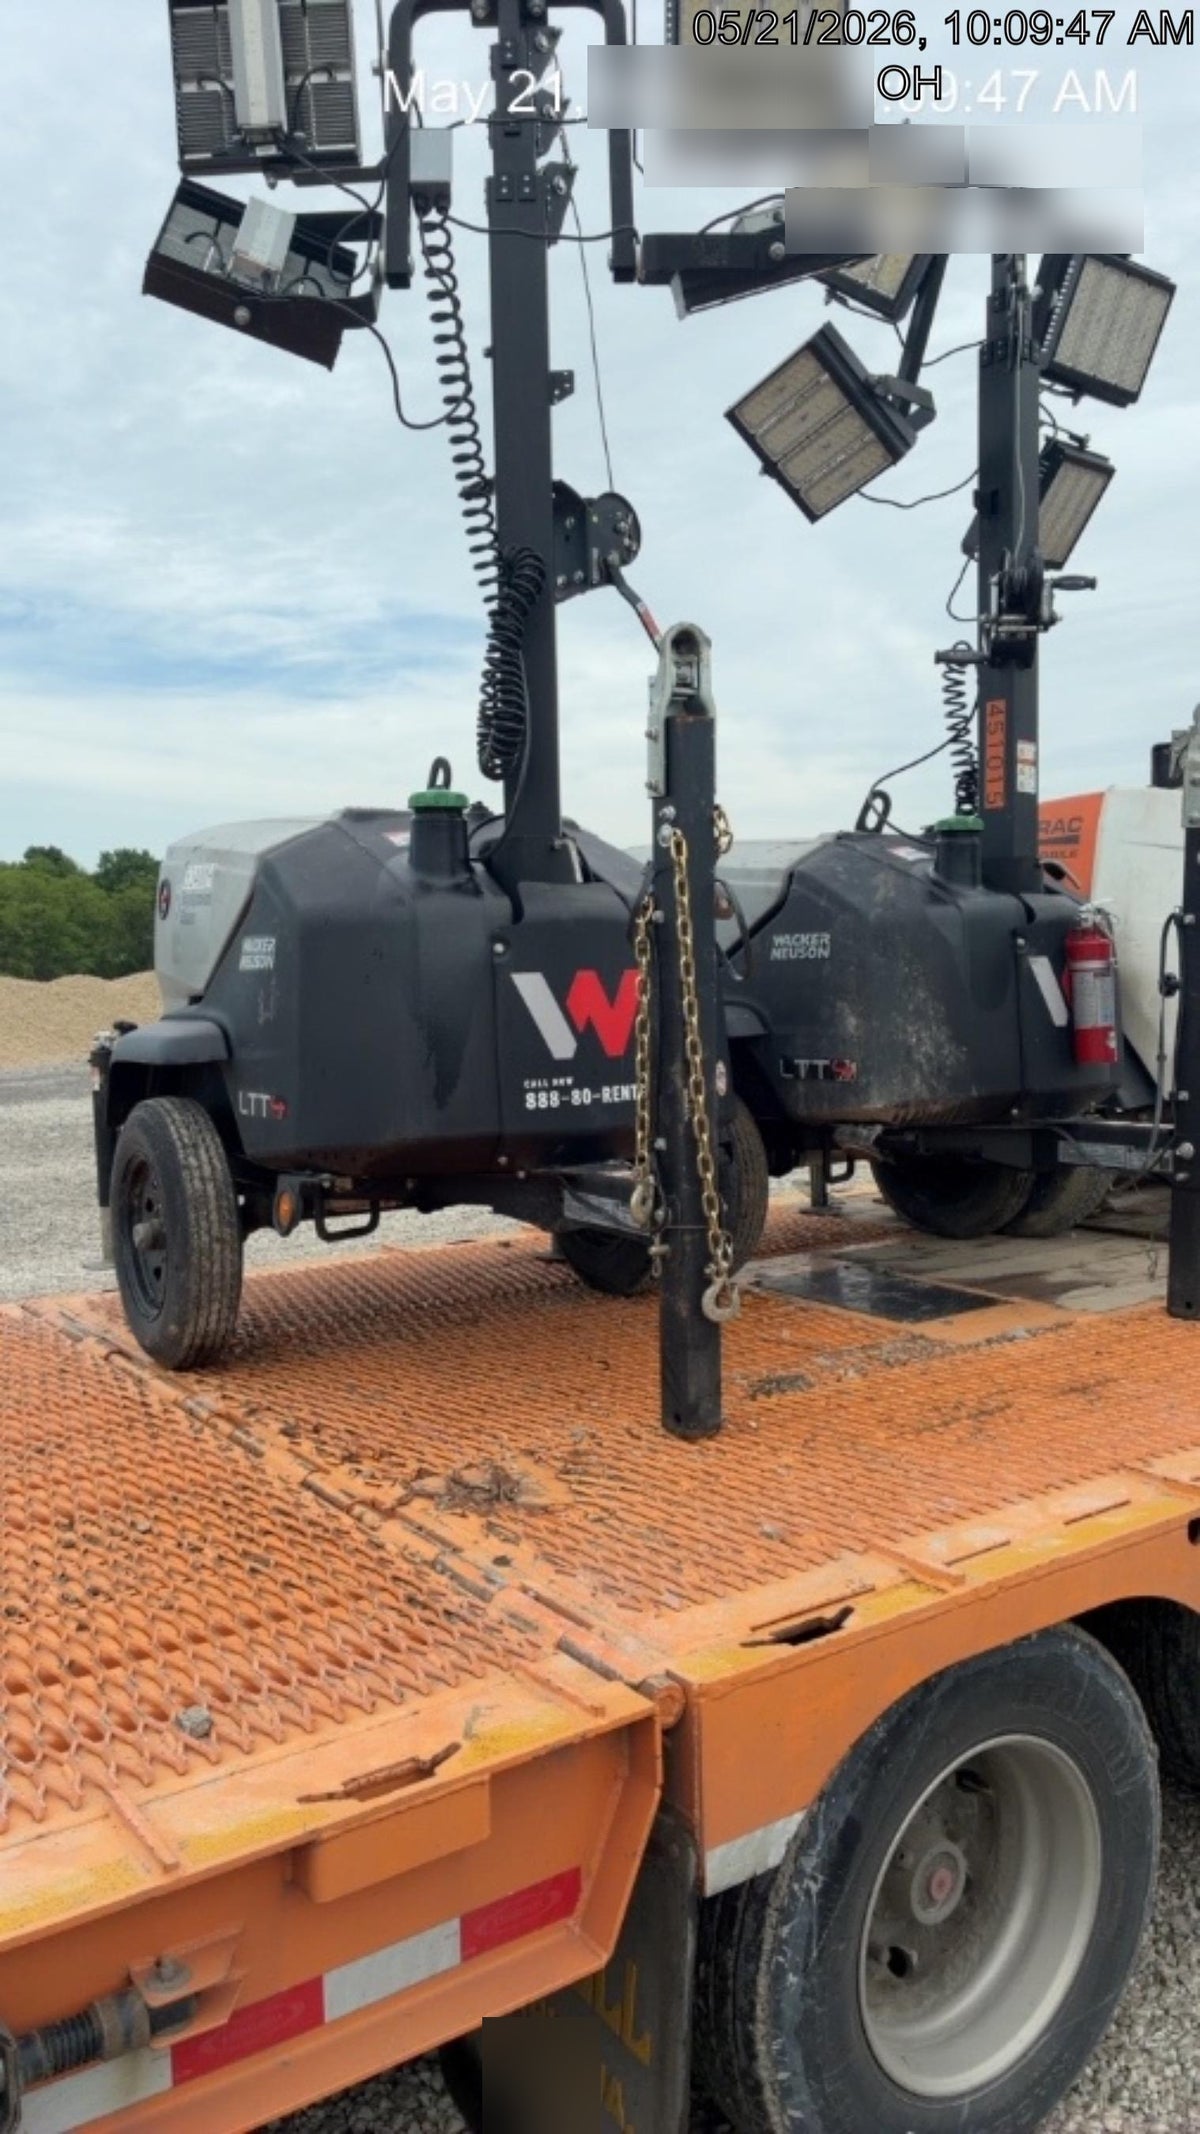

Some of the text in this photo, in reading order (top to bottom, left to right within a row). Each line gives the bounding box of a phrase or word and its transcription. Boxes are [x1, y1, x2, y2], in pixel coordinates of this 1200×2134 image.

[987, 703, 1005, 805] 451015
[772, 932, 831, 948] WACKER
[770, 947, 831, 961] NEUSON
[523, 1076, 574, 1089] CALL NOW
[525, 1084, 638, 1110] 888-80-RENT
